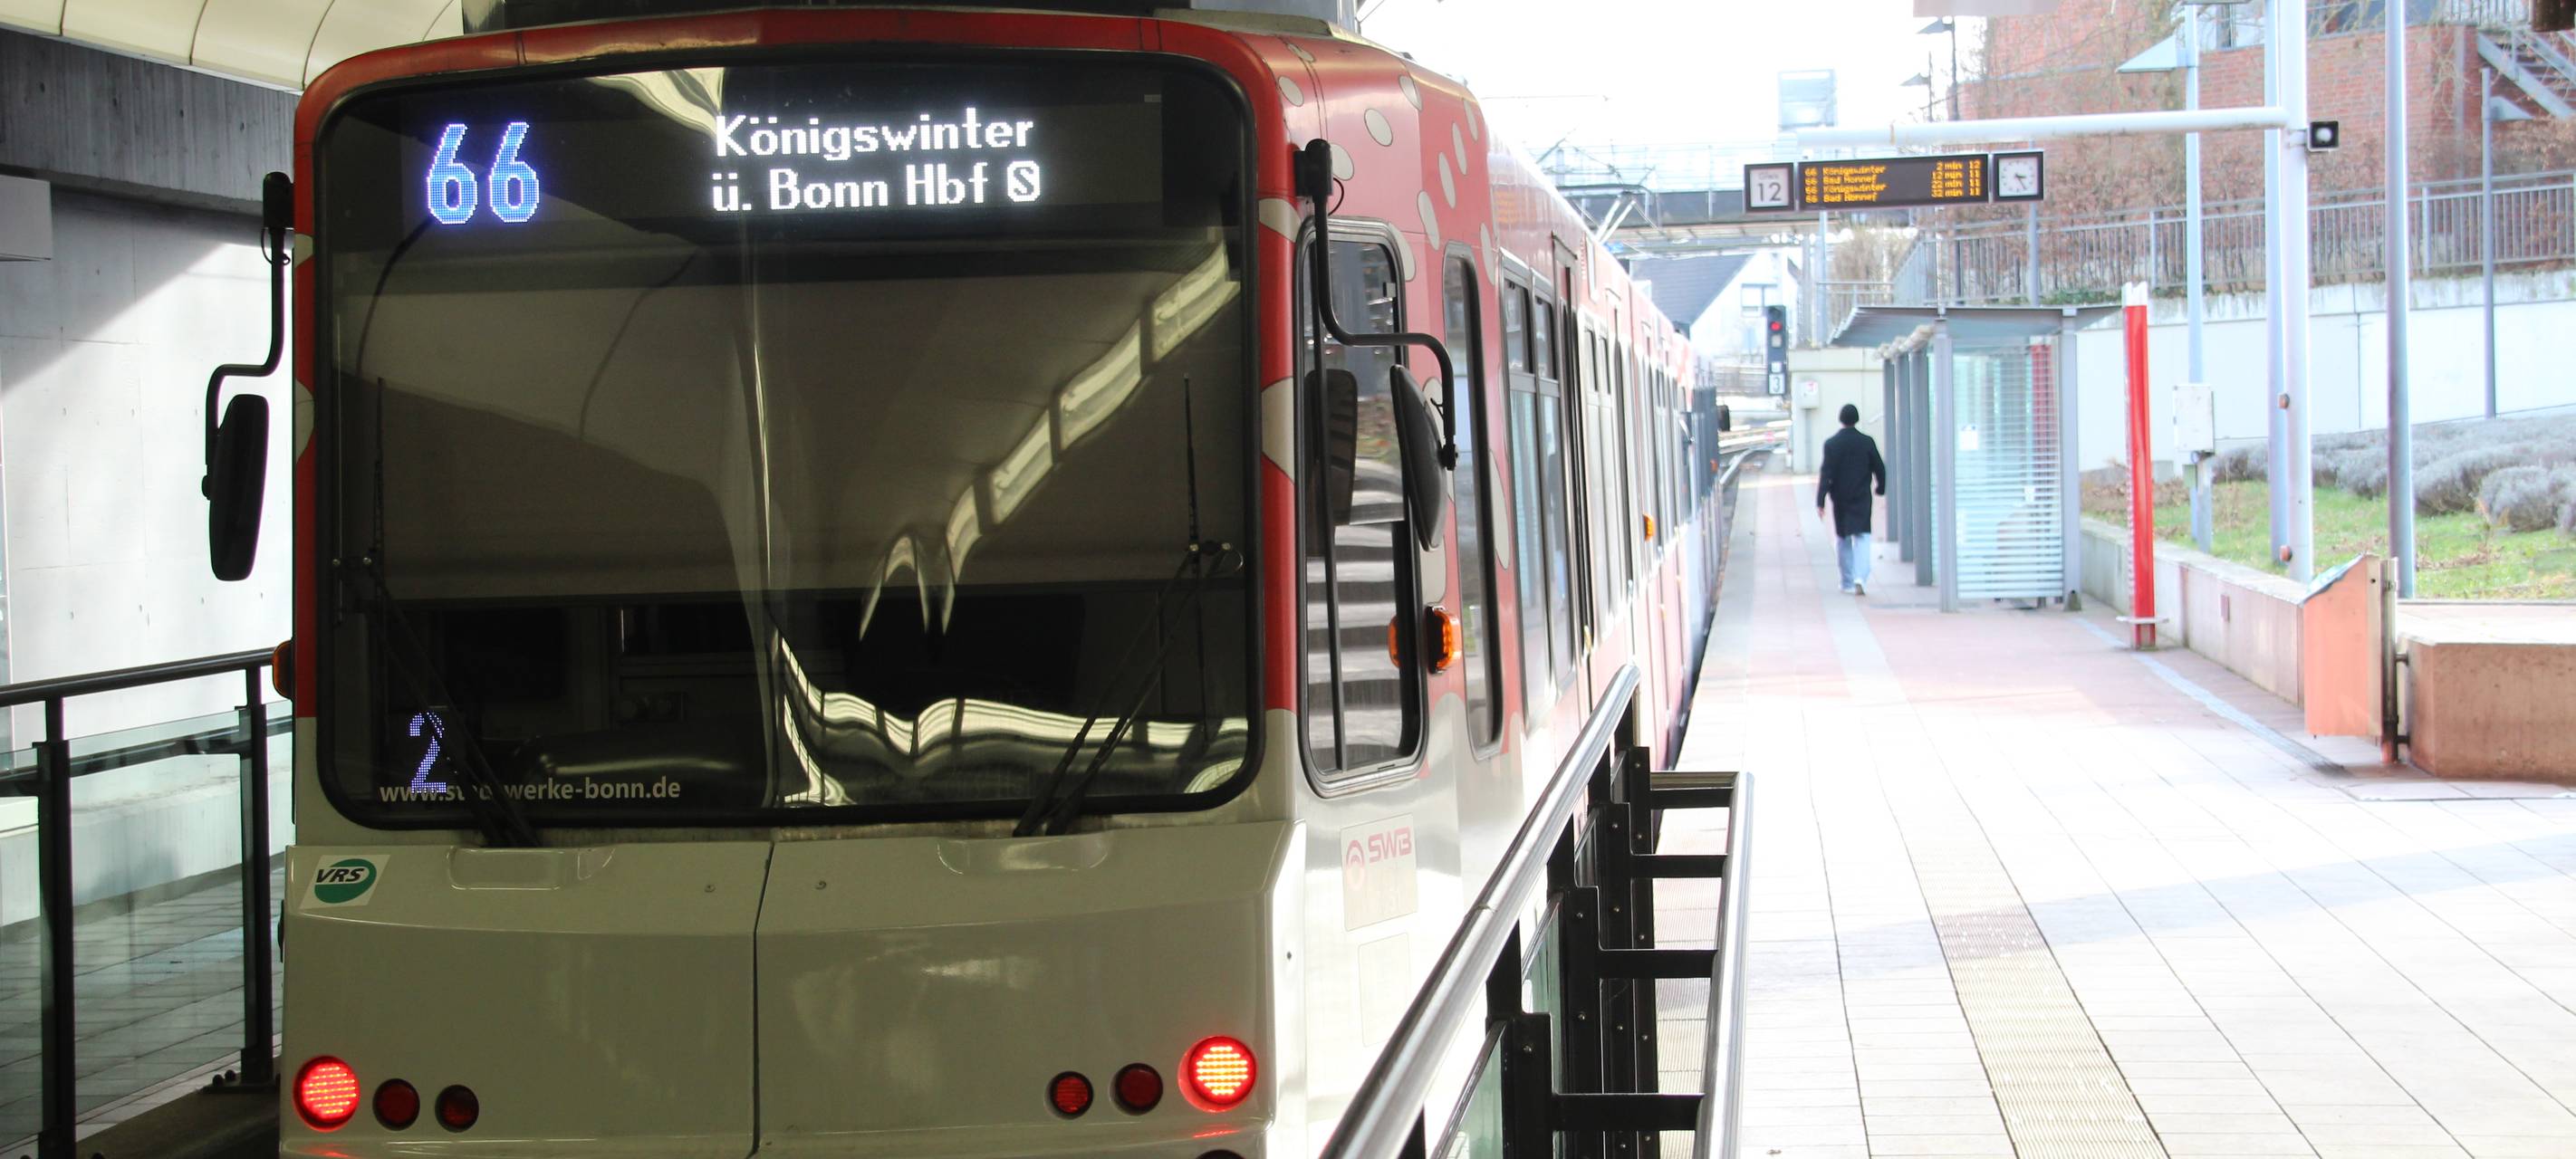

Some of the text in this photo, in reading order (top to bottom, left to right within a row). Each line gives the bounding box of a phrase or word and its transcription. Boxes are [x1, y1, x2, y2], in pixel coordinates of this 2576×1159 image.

[716, 108, 1033, 161] Königswinter
[427, 121, 540, 225] 66
[1944, 161, 1963, 170] min
[713, 172, 753, 213] ü.
[770, 168, 889, 211] Bonn
[906, 161, 989, 207] Hbf
[1822, 176, 1841, 185] Bad
[1843, 174, 1878, 185] Honnef
[1944, 170, 1963, 179] min
[1944, 178, 1963, 188] min
[1757, 181, 1783, 203] 12
[1822, 194, 1841, 203] Bad
[1843, 191, 1878, 202] Honnef
[1945, 187, 1963, 197] min
[409, 711, 447, 794] 2
[1368, 826, 1412, 863] SWB
[315, 867, 364, 884] VRS
